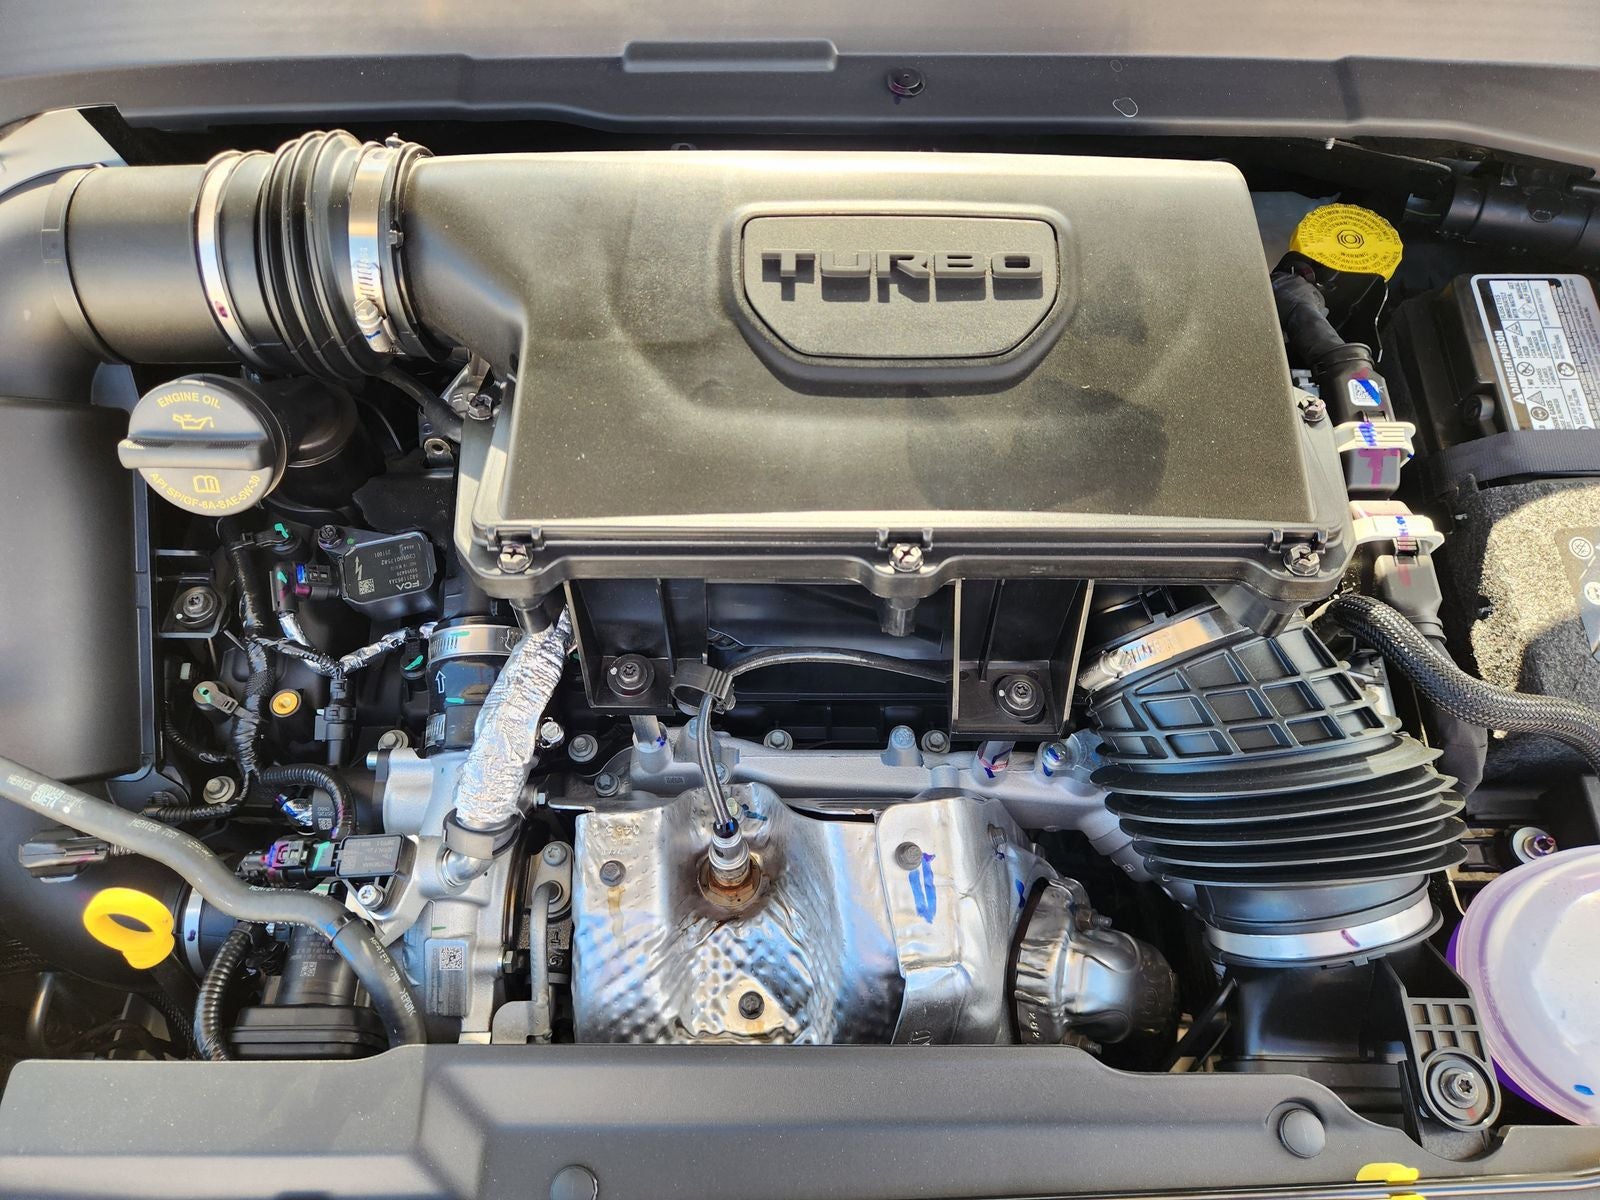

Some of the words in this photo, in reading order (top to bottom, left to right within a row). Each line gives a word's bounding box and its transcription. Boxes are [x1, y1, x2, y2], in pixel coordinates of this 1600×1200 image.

[761, 249, 1043, 291] TURBO
[1494, 330, 1522, 394] DANGER/POISON
[157, 391, 199, 408] ENGINE
[202, 394, 221, 409] OIL
[396, 580, 419, 591] FCA
[128, 818, 161, 832] HEATER
[369, 936, 391, 964] HEATER
